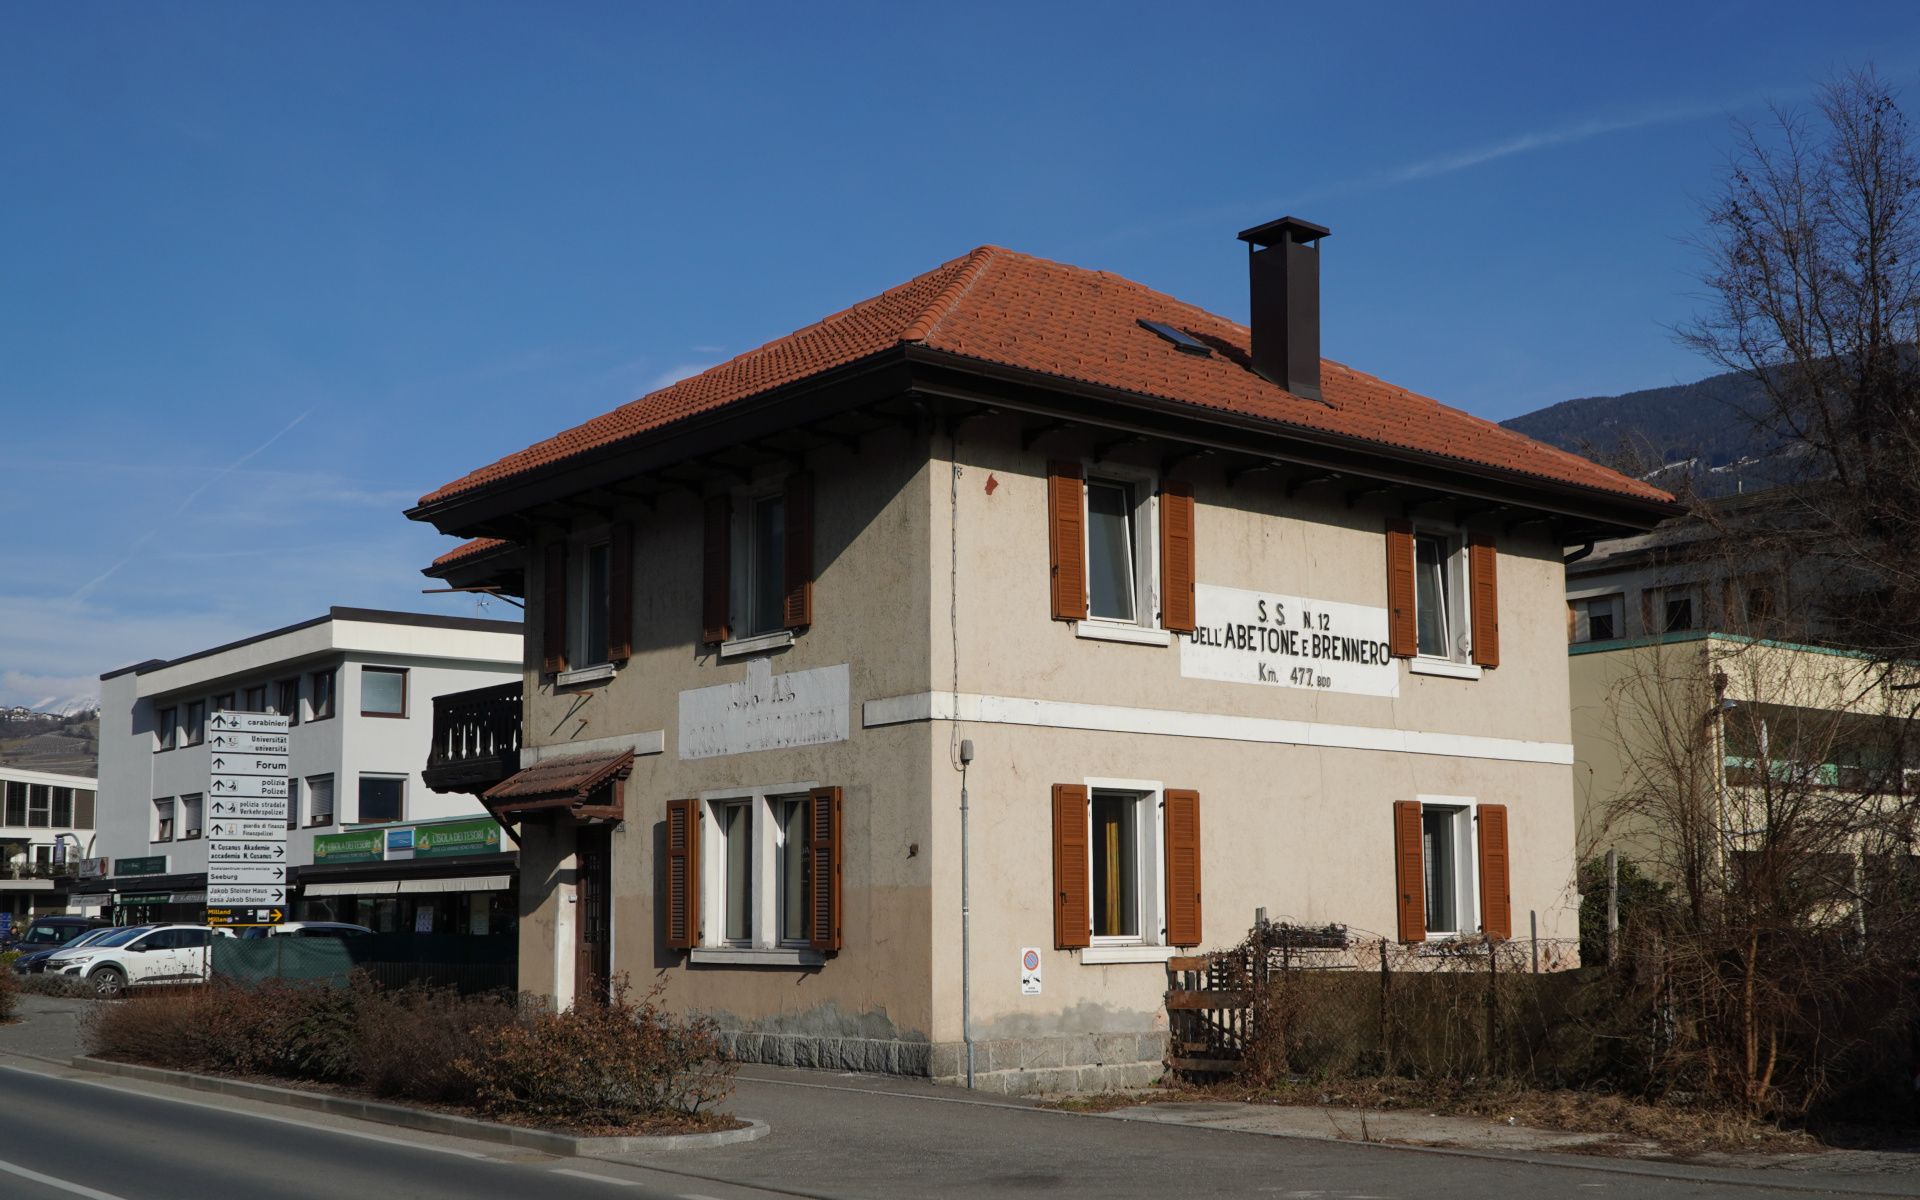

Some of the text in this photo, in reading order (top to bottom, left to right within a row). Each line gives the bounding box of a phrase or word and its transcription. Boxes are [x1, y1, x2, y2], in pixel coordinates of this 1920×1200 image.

[1303, 611, 1314, 630] N.
[1318, 612, 1330, 631] 12
[1302, 639, 1309, 657] E
[1312, 633, 1391, 666] BRENNERO
[1258, 662, 1279, 683] Km.
[251, 736, 287, 744] Universität
[256, 761, 287, 769] Forum
